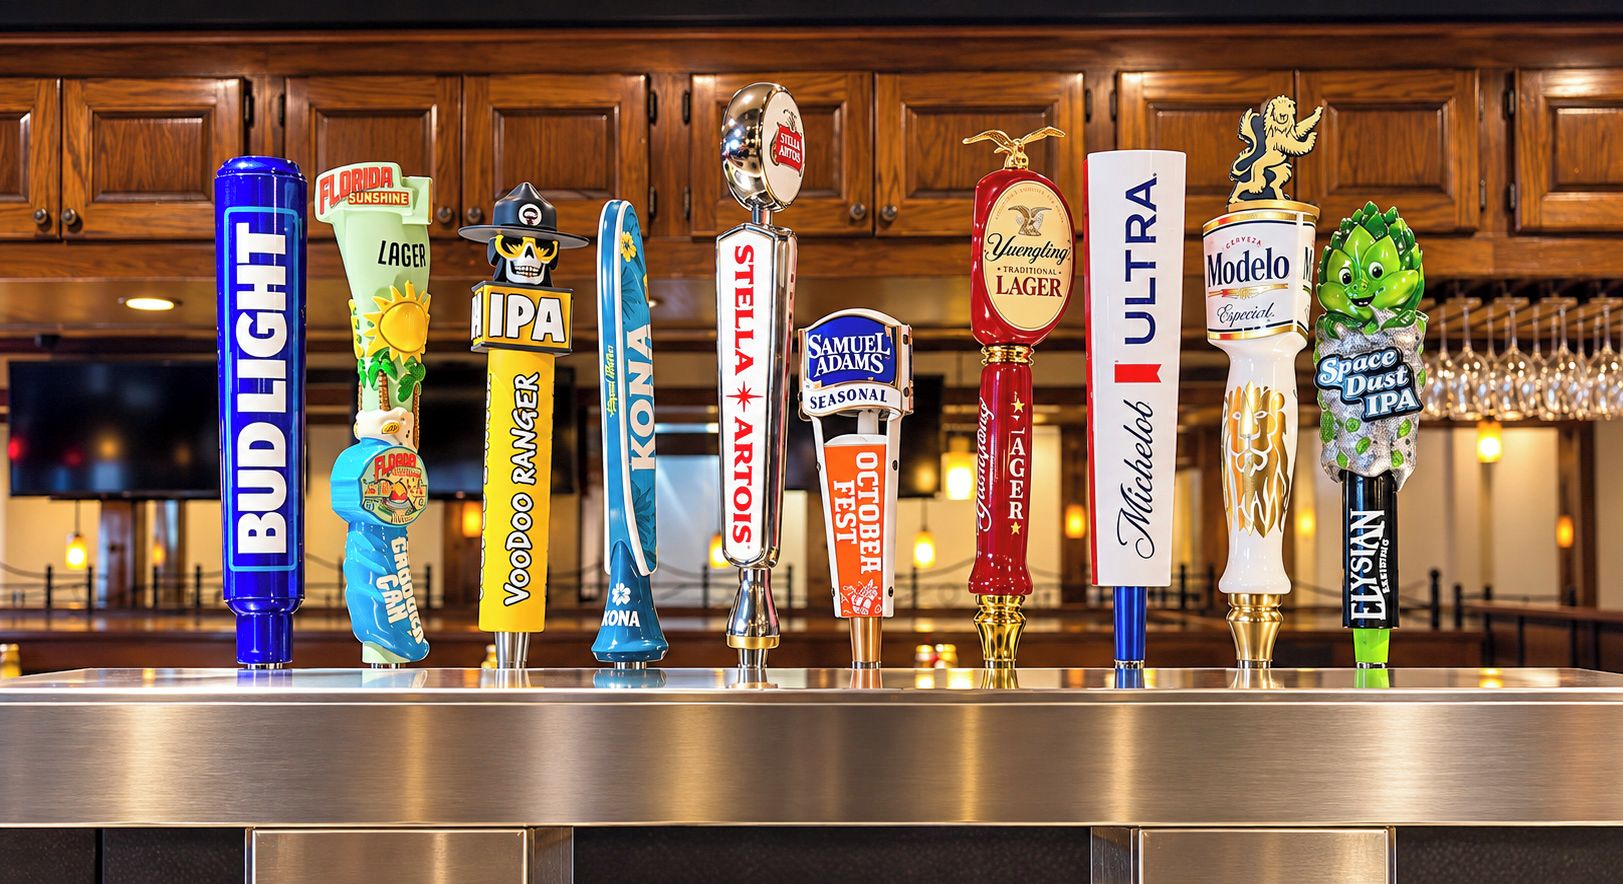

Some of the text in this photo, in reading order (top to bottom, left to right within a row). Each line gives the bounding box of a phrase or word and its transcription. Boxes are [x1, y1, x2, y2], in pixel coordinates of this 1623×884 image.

[319, 166, 394, 215] FLORIDA
[348, 192, 408, 204] SUNSHINE
[378, 240, 426, 268] LAGER
[985, 232, 1068, 265] Yuengling
[1225, 236, 1263, 250] CERVEZA
[1003, 266, 1057, 276] TRADITIONAL
[1124, 177, 1158, 345] ULTRA
[1207, 246, 1290, 288] Modelo
[996, 275, 1063, 298] LAGER
[489, 293, 566, 342] IPA
[808, 332, 891, 359] SAMUEL
[813, 353, 884, 378] ADAMS
[1318, 349, 1398, 384] Space
[1344, 364, 1410, 399] Dust
[236, 222, 288, 554] BUD LIGHT
[626, 324, 656, 471] KONA
[732, 244, 755, 544] STELLA ARTOIS
[810, 388, 888, 410] SEASONAL
[1366, 386, 1421, 418] IPA
[510, 371, 540, 486] RANGER
[1116, 399, 1156, 560] Michelob
[833, 480, 858, 545] FEST
[1350, 508, 1387, 621] ELYSIAN
[376, 574, 409, 625] CAN
[600, 609, 641, 628] KONA
